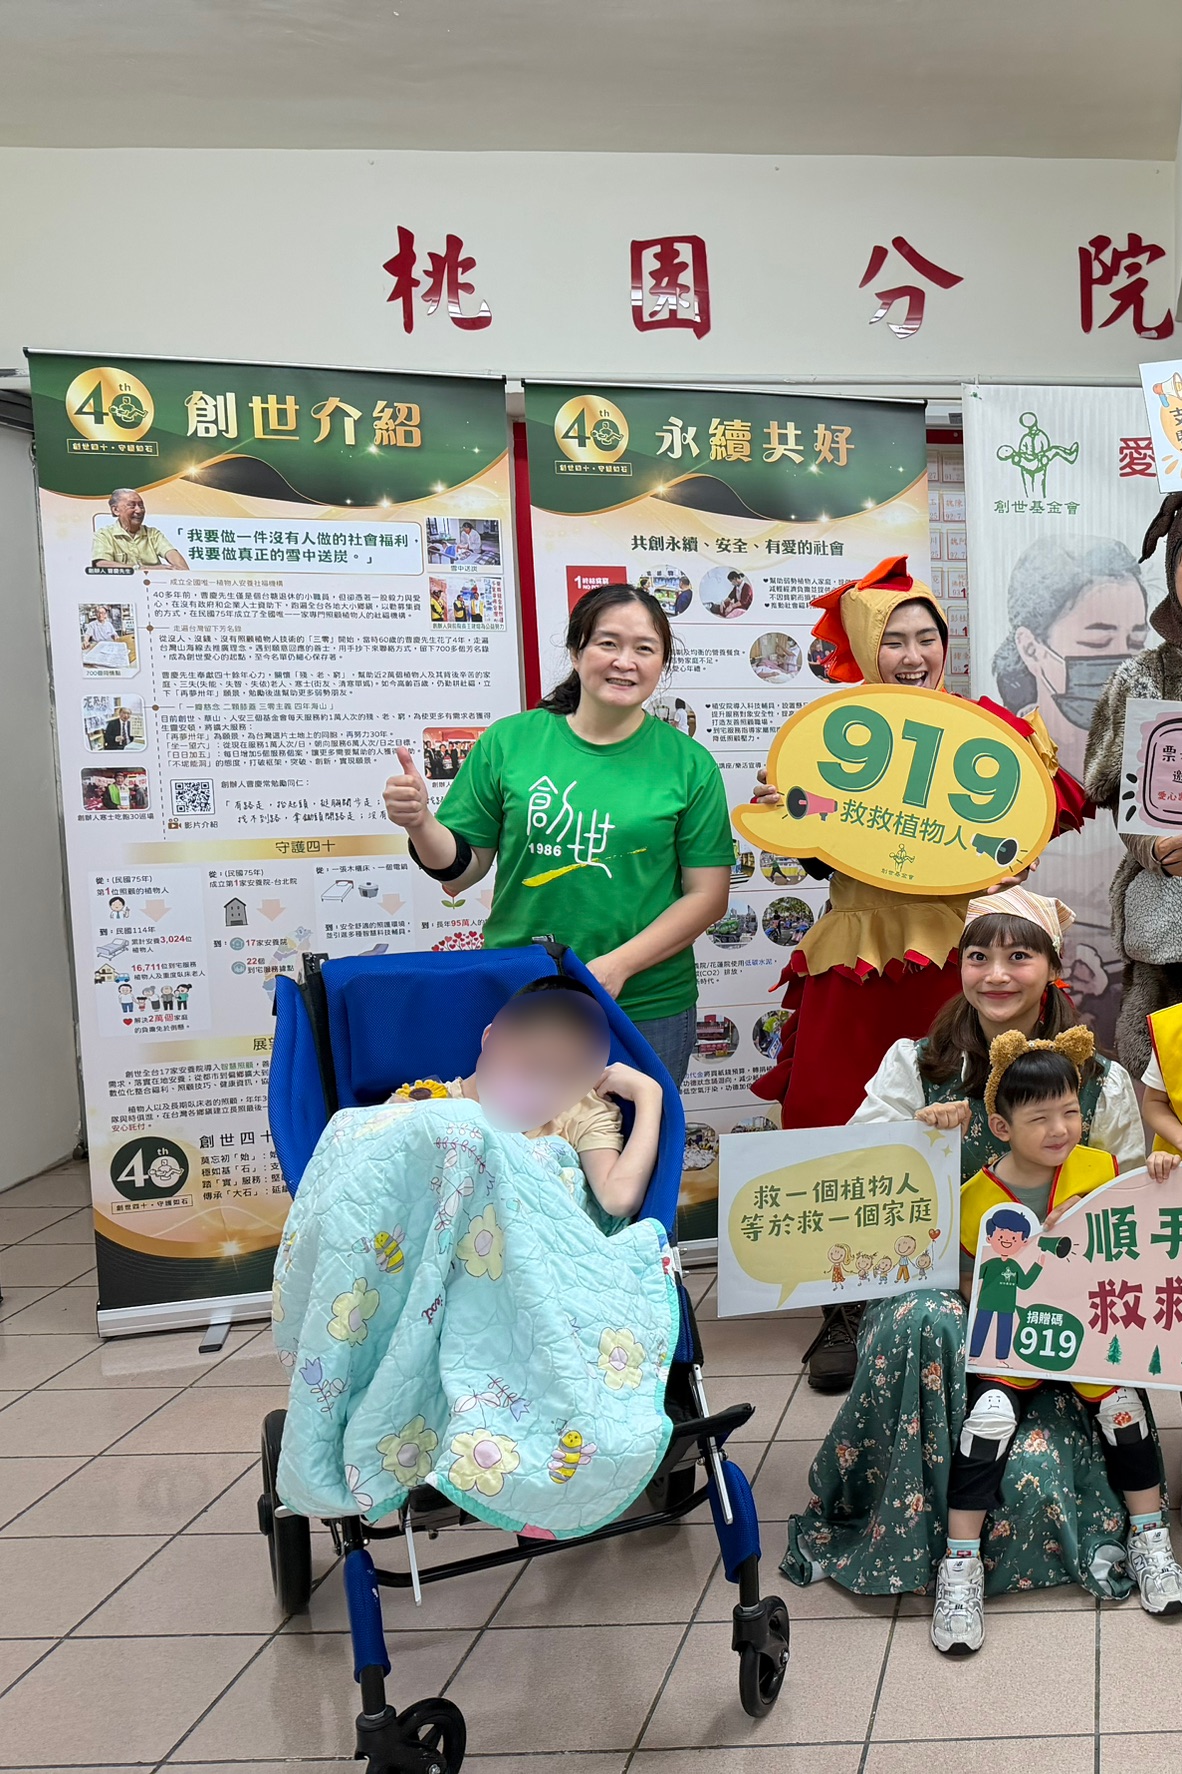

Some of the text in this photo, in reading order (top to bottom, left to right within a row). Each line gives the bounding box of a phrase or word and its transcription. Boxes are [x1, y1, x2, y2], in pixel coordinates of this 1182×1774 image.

[185, 391, 422, 448] 創世介紹
[655, 416, 855, 467] 永續共好
[993, 500, 1081, 515] 創世基金會
[817, 704, 1021, 824] 919
[841, 799, 968, 851] 救救植物人
[275, 840, 336, 855] 守護四十
[528, 842, 562, 857] 1986
[753, 1172, 920, 1210] 救一個植物人
[740, 1197, 932, 1243] 等於救一個家庭
[1026, 1308, 1064, 1327] 捐贈碼
[1018, 1325, 1078, 1361] 919
